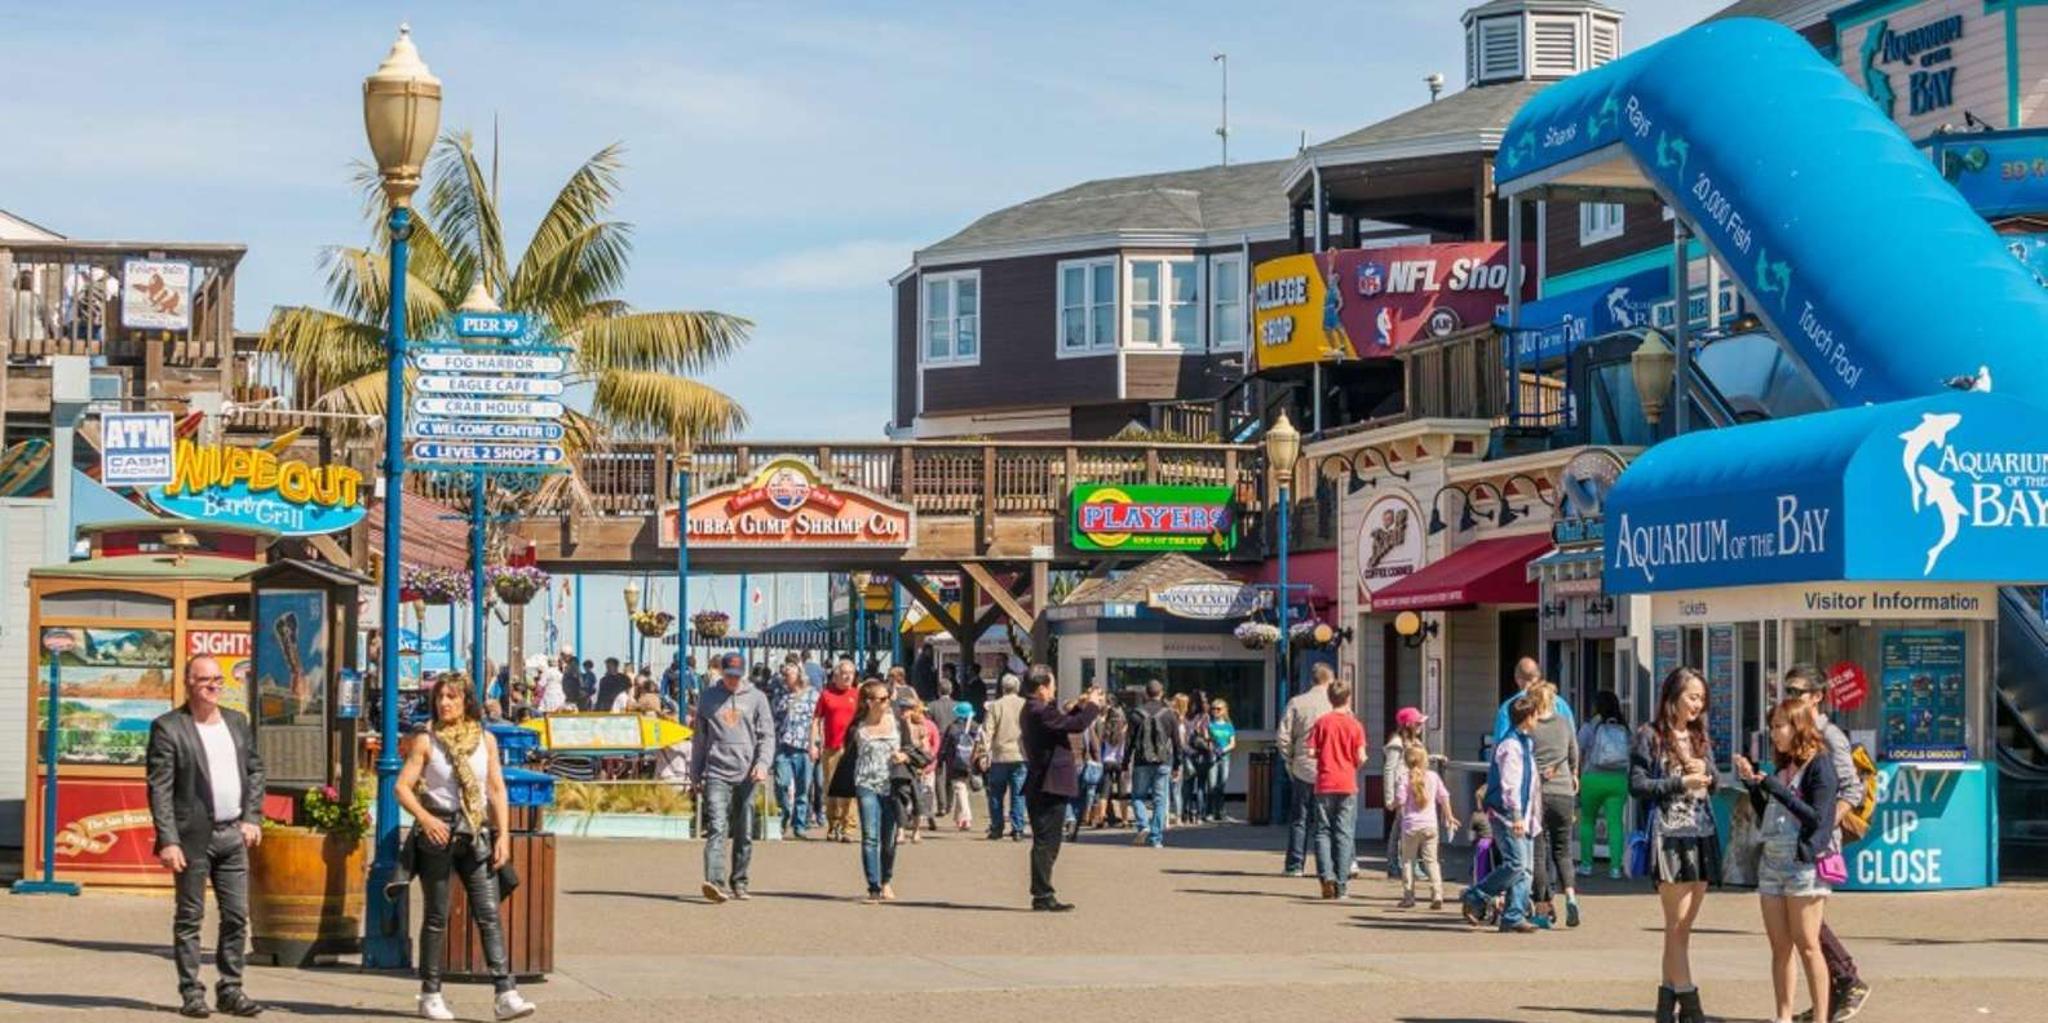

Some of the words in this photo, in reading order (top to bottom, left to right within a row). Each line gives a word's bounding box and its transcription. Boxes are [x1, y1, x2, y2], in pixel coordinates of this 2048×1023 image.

[1882, 15, 1964, 65] AQUARIUM
[1908, 67, 1957, 117] BAY
[1624, 94, 1653, 138] Rays
[1692, 172, 1730, 226] 20,000
[1724, 208, 1752, 256] Fish
[1386, 260, 1441, 294] NFL
[1449, 258, 1526, 296] Shop
[463, 318, 499, 332] PIER
[502, 318, 518, 332] 39
[1797, 299, 1833, 356] Touch
[1830, 342, 1862, 390] Pool
[445, 356, 474, 368] FOG
[477, 357, 534, 369] HARBOR
[449, 379, 491, 391] EAGLE
[496, 381, 530, 392] CAFE
[445, 401, 481, 413] CRAB
[486, 402, 532, 414] HOUSE
[106, 419, 170, 448] ATM
[431, 423, 493, 436] WELCOME
[496, 426, 544, 438] CENTER
[111, 457, 166, 467] CASH
[437, 446, 479, 458] LEVEL
[482, 447, 491, 459] 2
[494, 448, 540, 461] SHOPS
[110, 467, 167, 475] MACHINE
[165, 437, 363, 507] WIPEOUT
[2003, 475, 2020, 488] OF
[2025, 475, 2048, 488] THE
[203, 488, 240, 516] Bar
[255, 499, 304, 531] Grill
[1084, 506, 1228, 529] PLAYERS
[1970, 483, 2048, 528] BAY
[741, 515, 789, 534] GUMP
[796, 515, 863, 534] SHRIMP
[869, 513, 900, 534] CO.
[1614, 513, 1729, 583] AQUARIUM
[1729, 536, 1747, 560] OF
[1749, 532, 1776, 558] THE
[1777, 494, 1830, 555] BAY
[1157, 594, 1197, 604] MONEY
[1679, 600, 1708, 617] Tickets
[1804, 591, 1867, 611] Visitor
[1872, 591, 1979, 611] Information
[1888, 749, 1926, 760] LOCALS
[1875, 768, 1927, 803] BAY
[1881, 809, 1920, 845] UP
[1856, 848, 1943, 885] CLOSE
